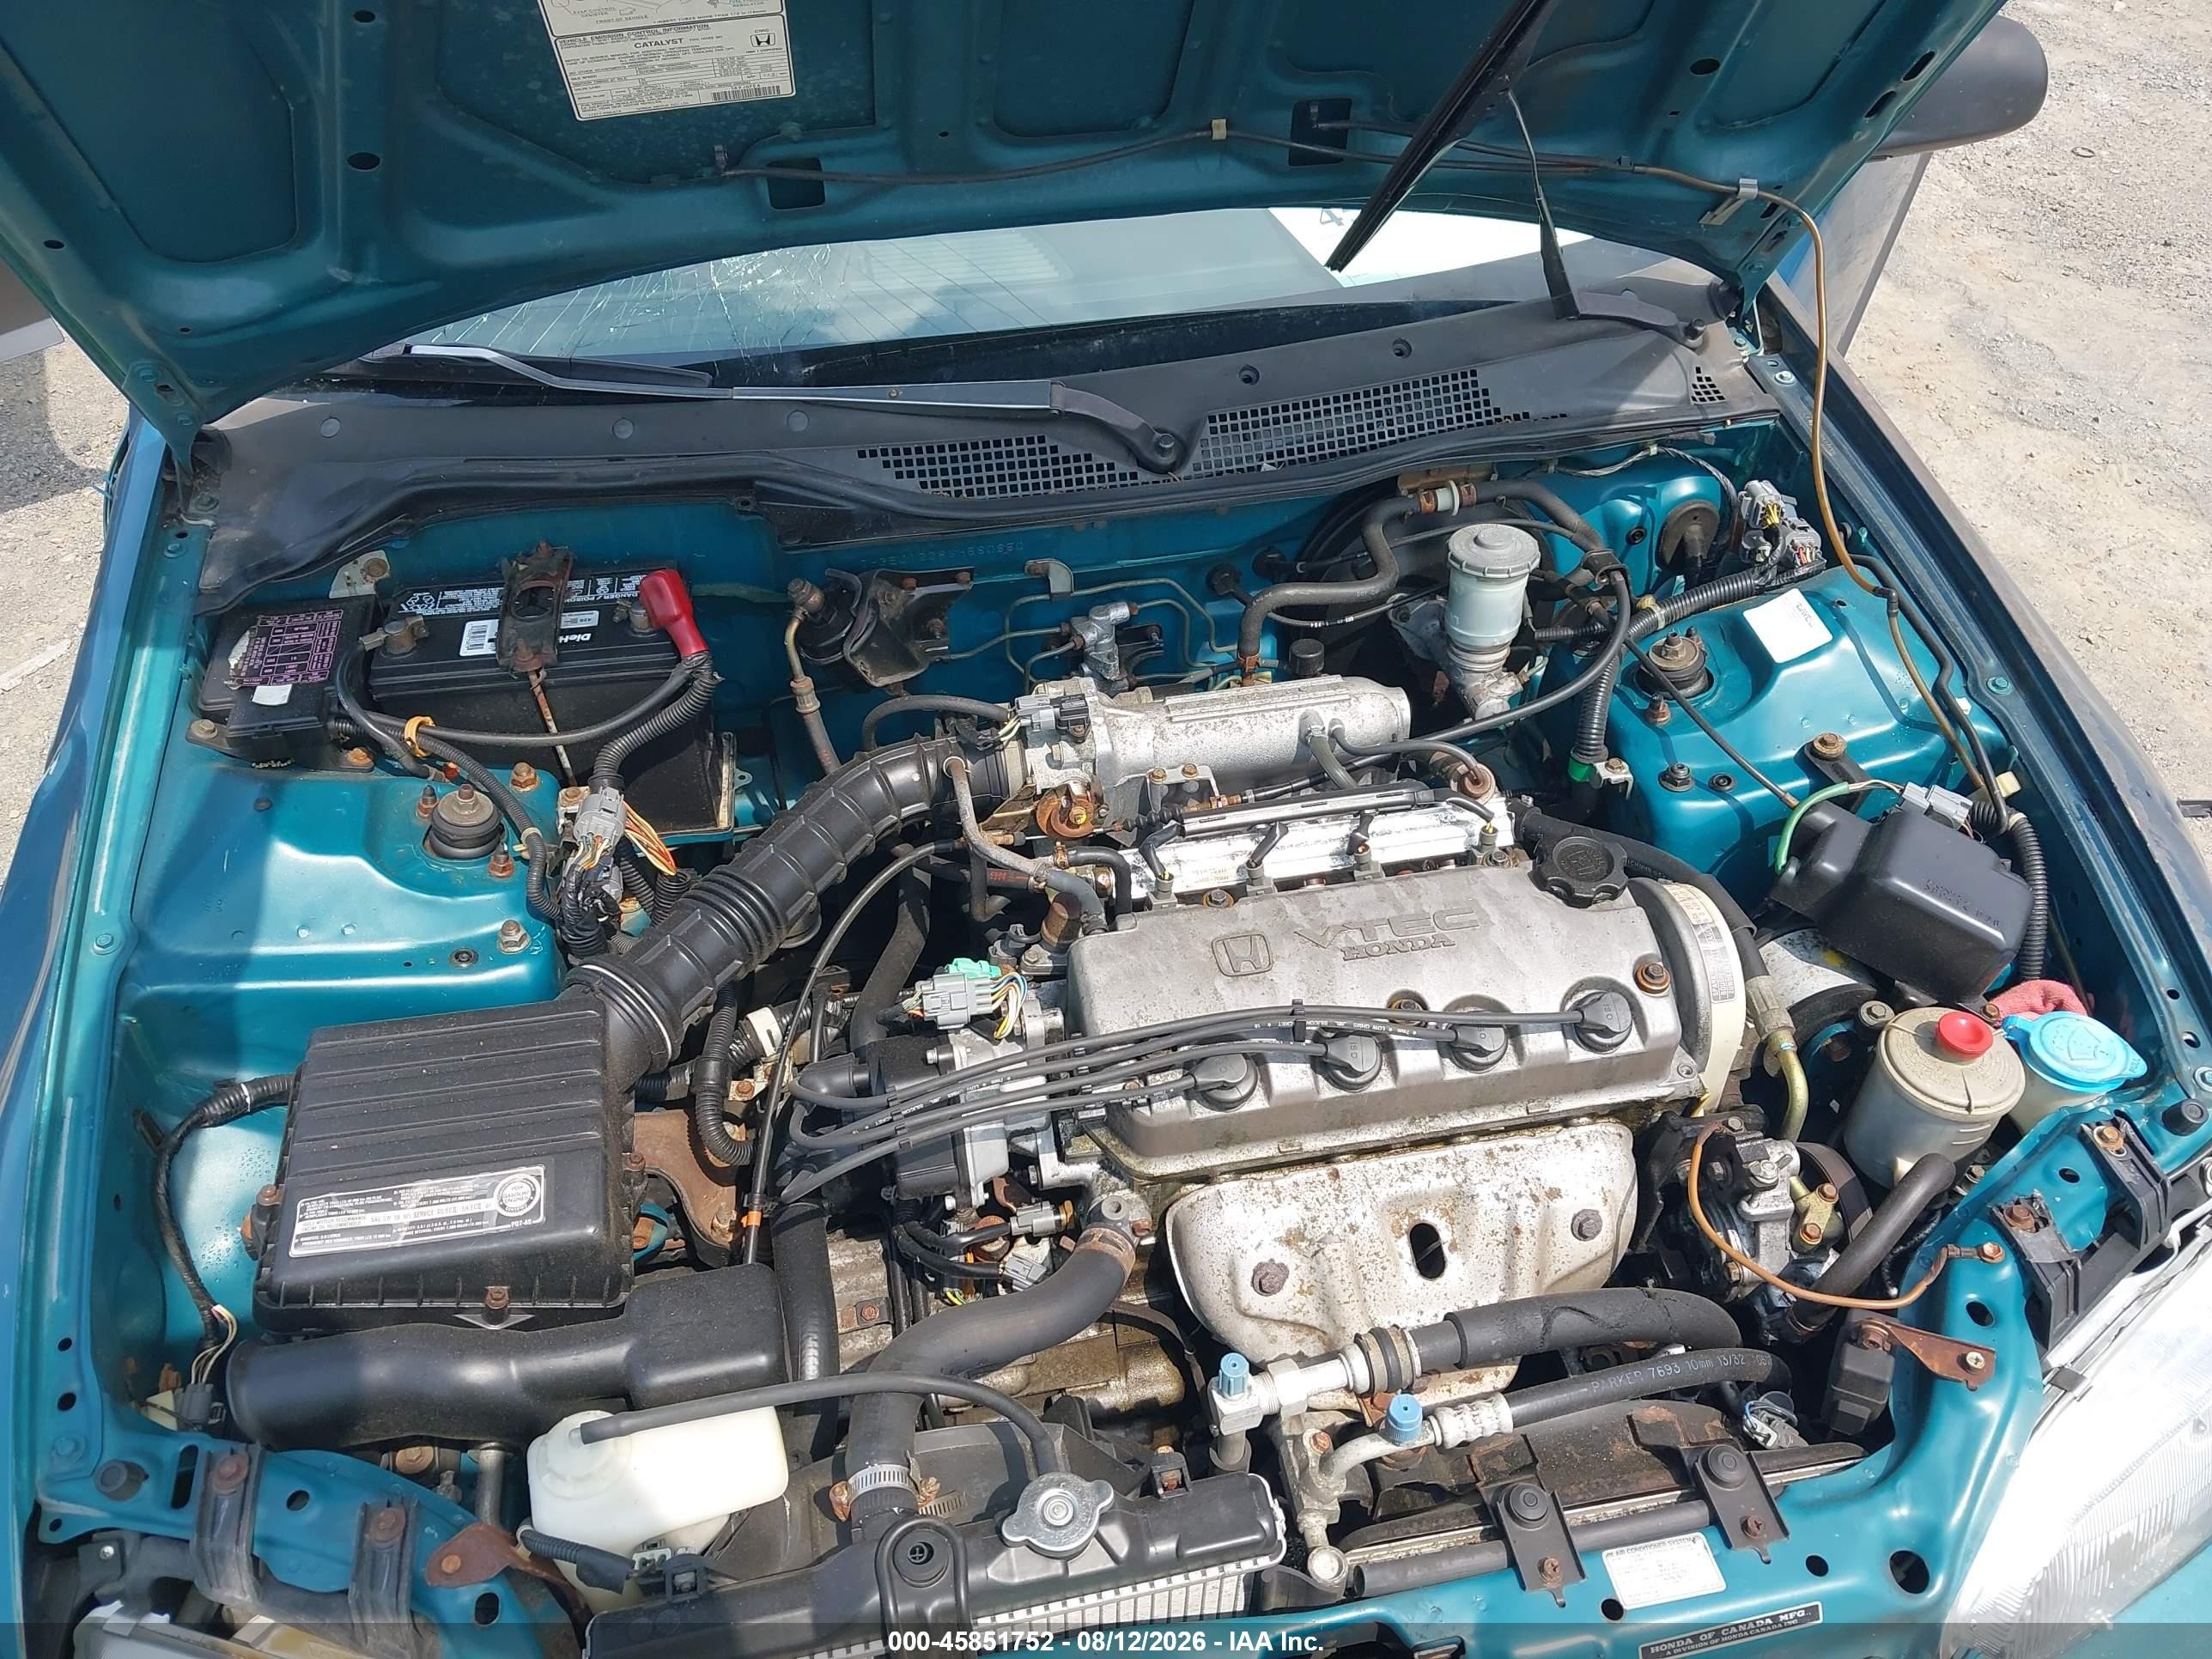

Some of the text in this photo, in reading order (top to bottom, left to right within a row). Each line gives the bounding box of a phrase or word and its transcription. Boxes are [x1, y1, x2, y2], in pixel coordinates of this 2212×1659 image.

[661, 23, 709, 32] INFORMATION
[633, 37, 684, 48] CATALYST
[558, 634, 591, 643] DieH
[1294, 905, 1480, 948] VTEC
[1340, 933, 1455, 962] HONDA
[413, 1209, 433, 1218] SERVICE
[1590, 1371, 1643, 1393] PRKER
[1648, 1362, 1680, 1379] 7693
[1686, 1358, 1714, 1370] 10mm
[1717, 1353, 1745, 1366] 13/32
[1616, 1547, 1626, 1556] AIR
[1626, 1540, 1667, 1554] CONDITIONER
[1650, 1638, 1693, 1654] HONDA
[1699, 1632, 1716, 1642] OF
[1721, 1618, 1772, 1636] CANADA
[1673, 1642, 1709, 1654] DIVISION
[1722, 1632, 1749, 1643] HONDA
[1749, 1622, 1783, 1635] CANADA
